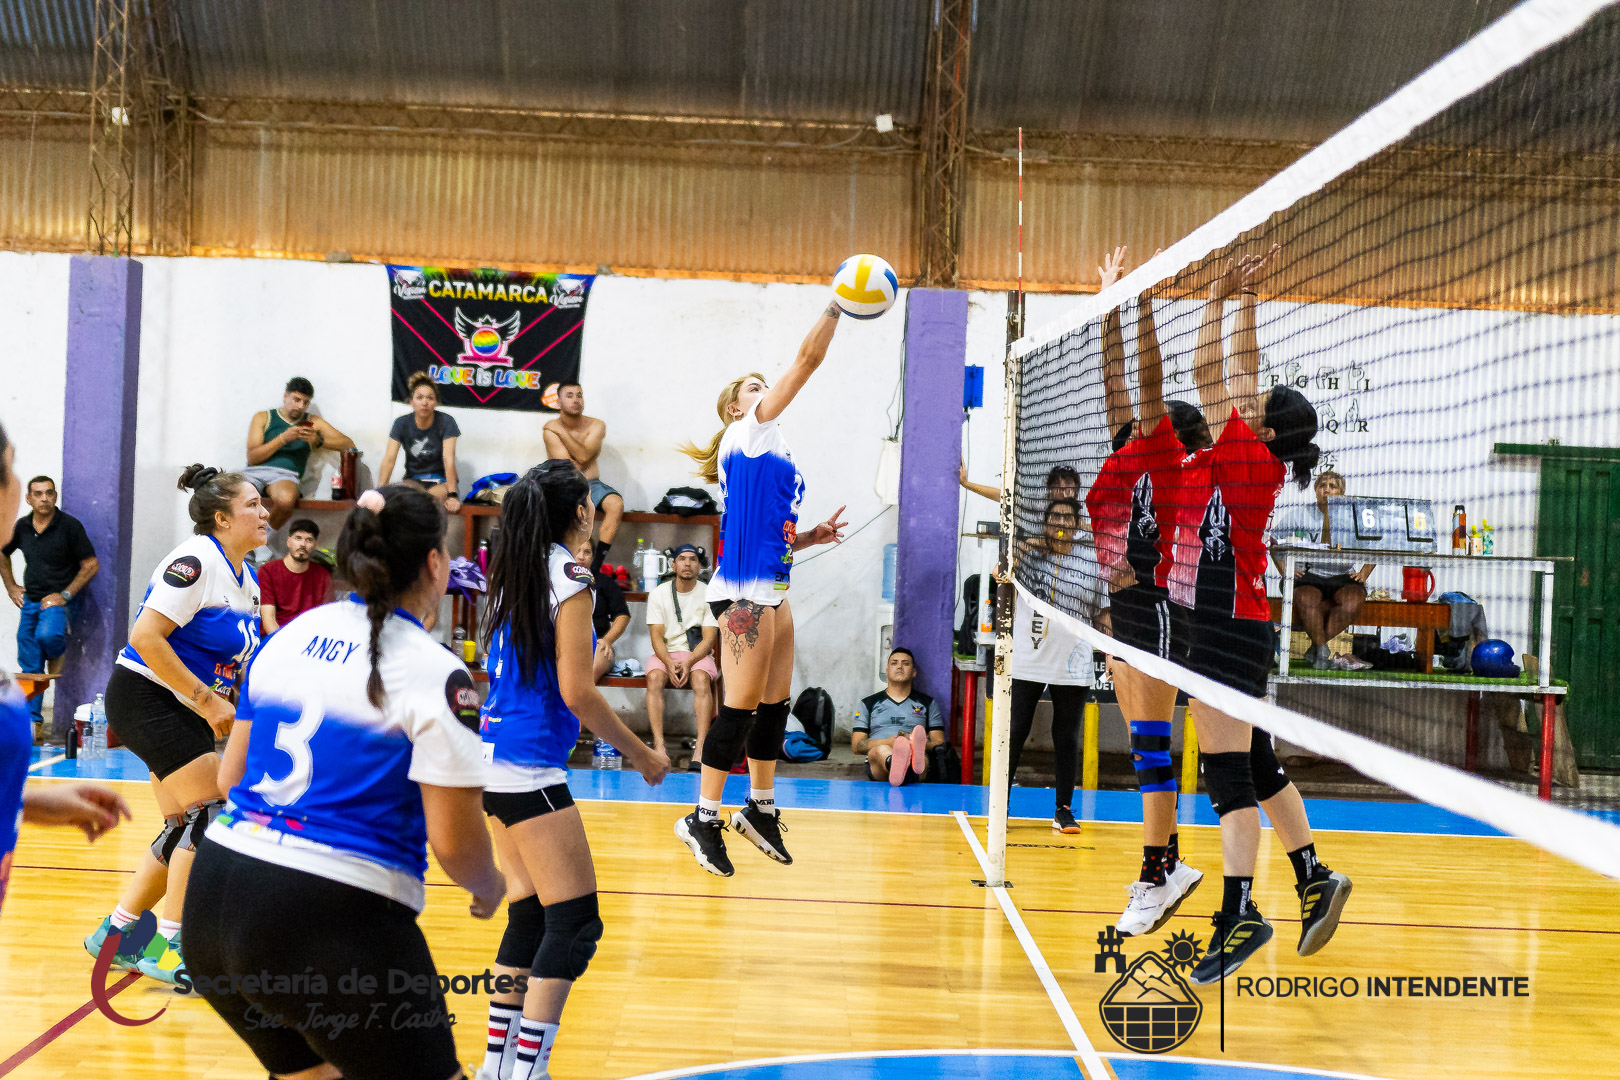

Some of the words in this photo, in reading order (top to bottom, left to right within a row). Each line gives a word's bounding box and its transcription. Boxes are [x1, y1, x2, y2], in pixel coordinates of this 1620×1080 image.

[428, 280, 548, 304] CATAMARCA
[429, 365, 474, 386] LOVE
[476, 368, 492, 387] is
[494, 369, 541, 389] LOVE
[1271, 374, 1280, 387] F
[1296, 375, 1308, 389] G
[1327, 377, 1339, 390] H
[1326, 419, 1339, 433] Q
[1358, 421, 1369, 433] R
[1362, 508, 1375, 528] 6
[1413, 512, 1426, 529] 6
[301, 635, 360, 664] ANGY
[249, 697, 326, 807] 3
